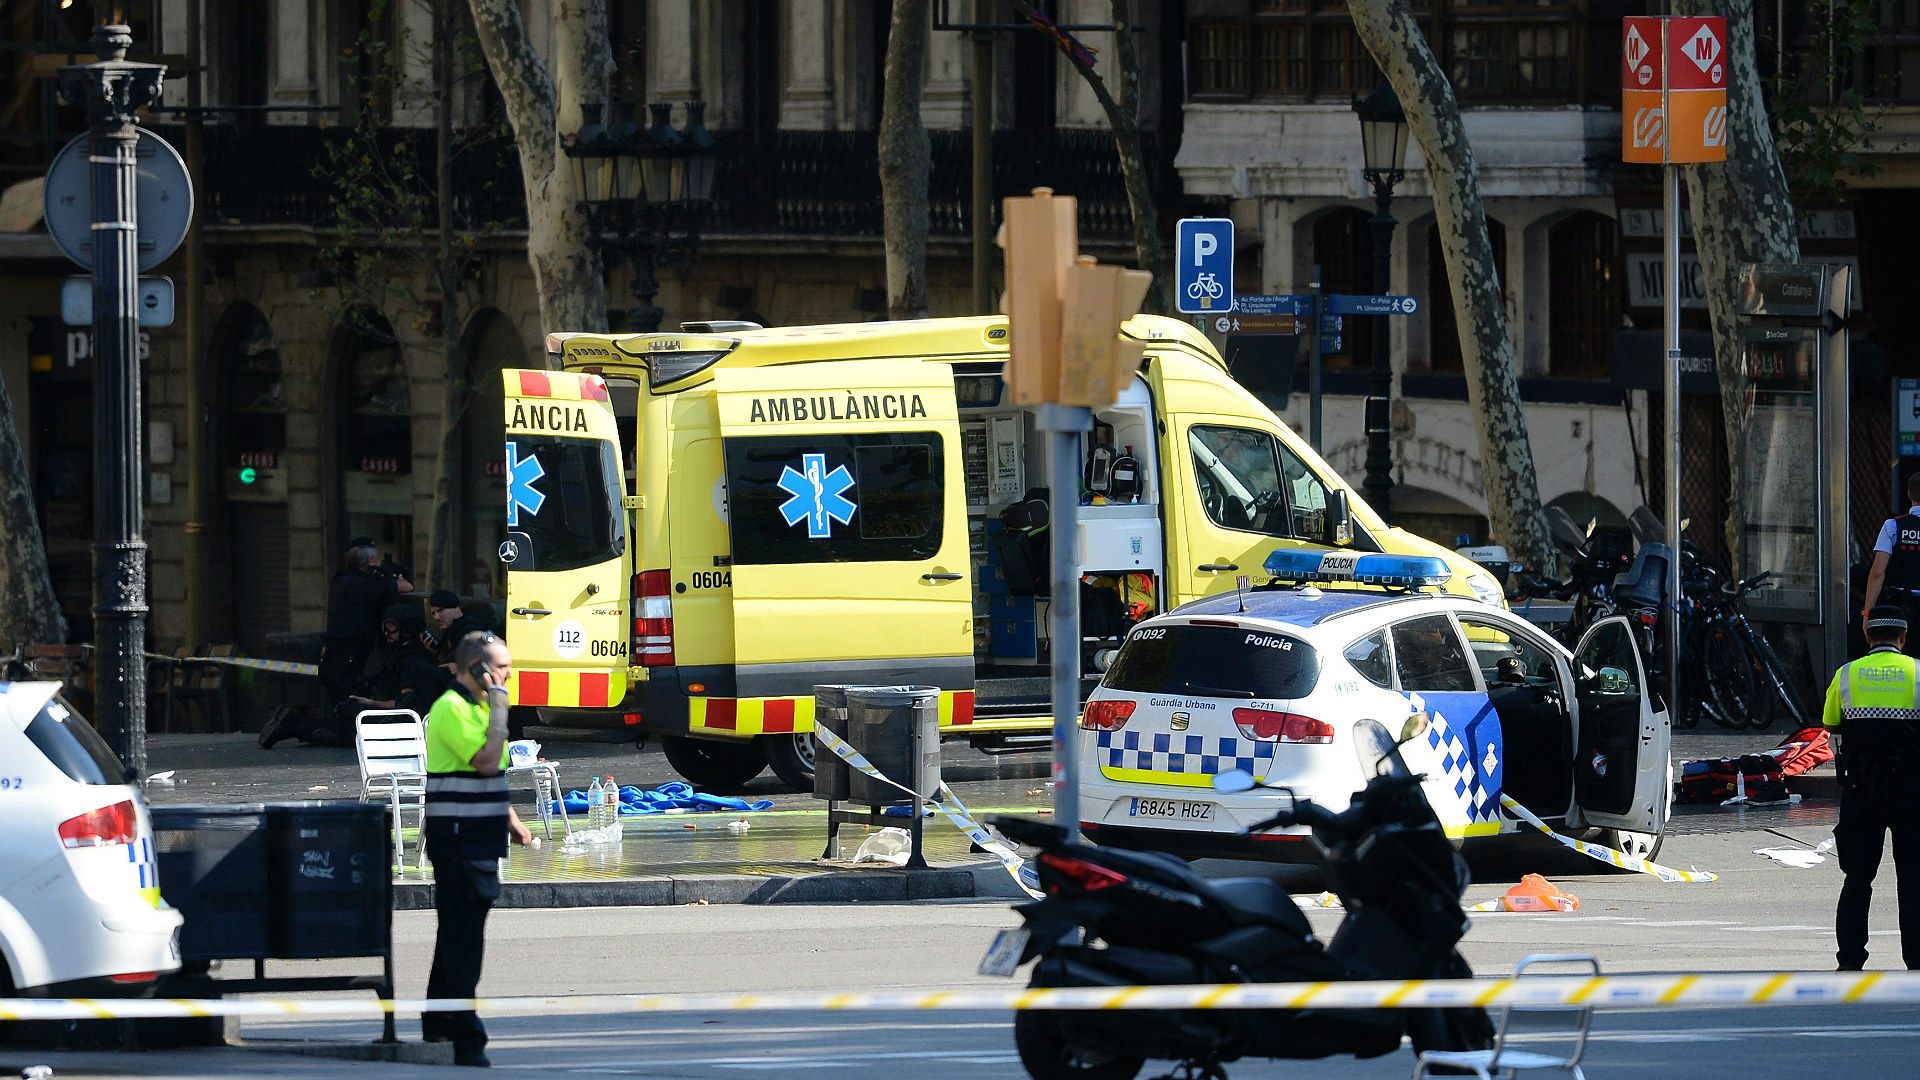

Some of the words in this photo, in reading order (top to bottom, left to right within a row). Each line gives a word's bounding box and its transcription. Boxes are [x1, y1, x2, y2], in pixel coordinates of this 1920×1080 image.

[1628, 37, 1639, 60] M
[1695, 37, 1712, 60] M
[1194, 233, 1218, 267] P
[1782, 283, 1812, 298] Catalunya
[750, 390, 927, 423] AMBULÀNCIA
[1322, 557, 1354, 569] POLICIA
[692, 571, 733, 589] 0604
[559, 630, 580, 643] 112
[1143, 628, 1167, 640] 092
[1245, 633, 1293, 651] Policia
[591, 639, 627, 657] 0604
[1150, 697, 1183, 709] Guàrdia
[1185, 699, 1217, 711] Urbana
[1250, 701, 1275, 710] C-711
[1139, 799, 1176, 816] 6845
[1181, 802, 1211, 819] HGZ
